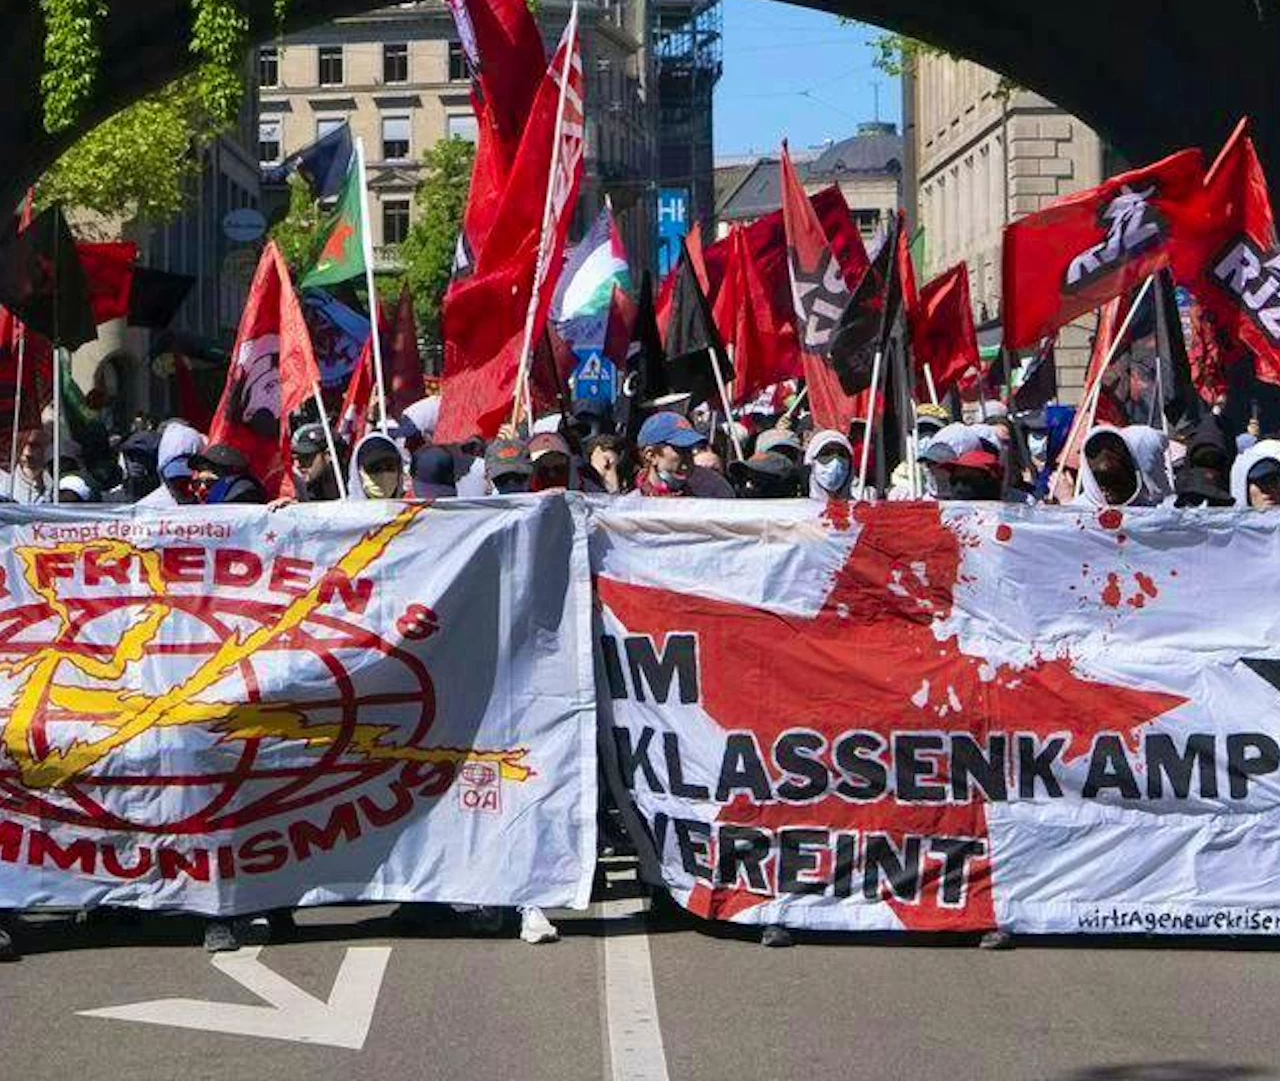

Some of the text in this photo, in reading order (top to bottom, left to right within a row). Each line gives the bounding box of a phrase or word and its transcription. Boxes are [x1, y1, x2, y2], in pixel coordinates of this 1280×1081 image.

[31, 519, 232, 541] Kampf dem Kapital
[36, 546, 375, 615] FRIEDEN
[602, 634, 697, 704] IM
[464, 789, 497, 810] OA
